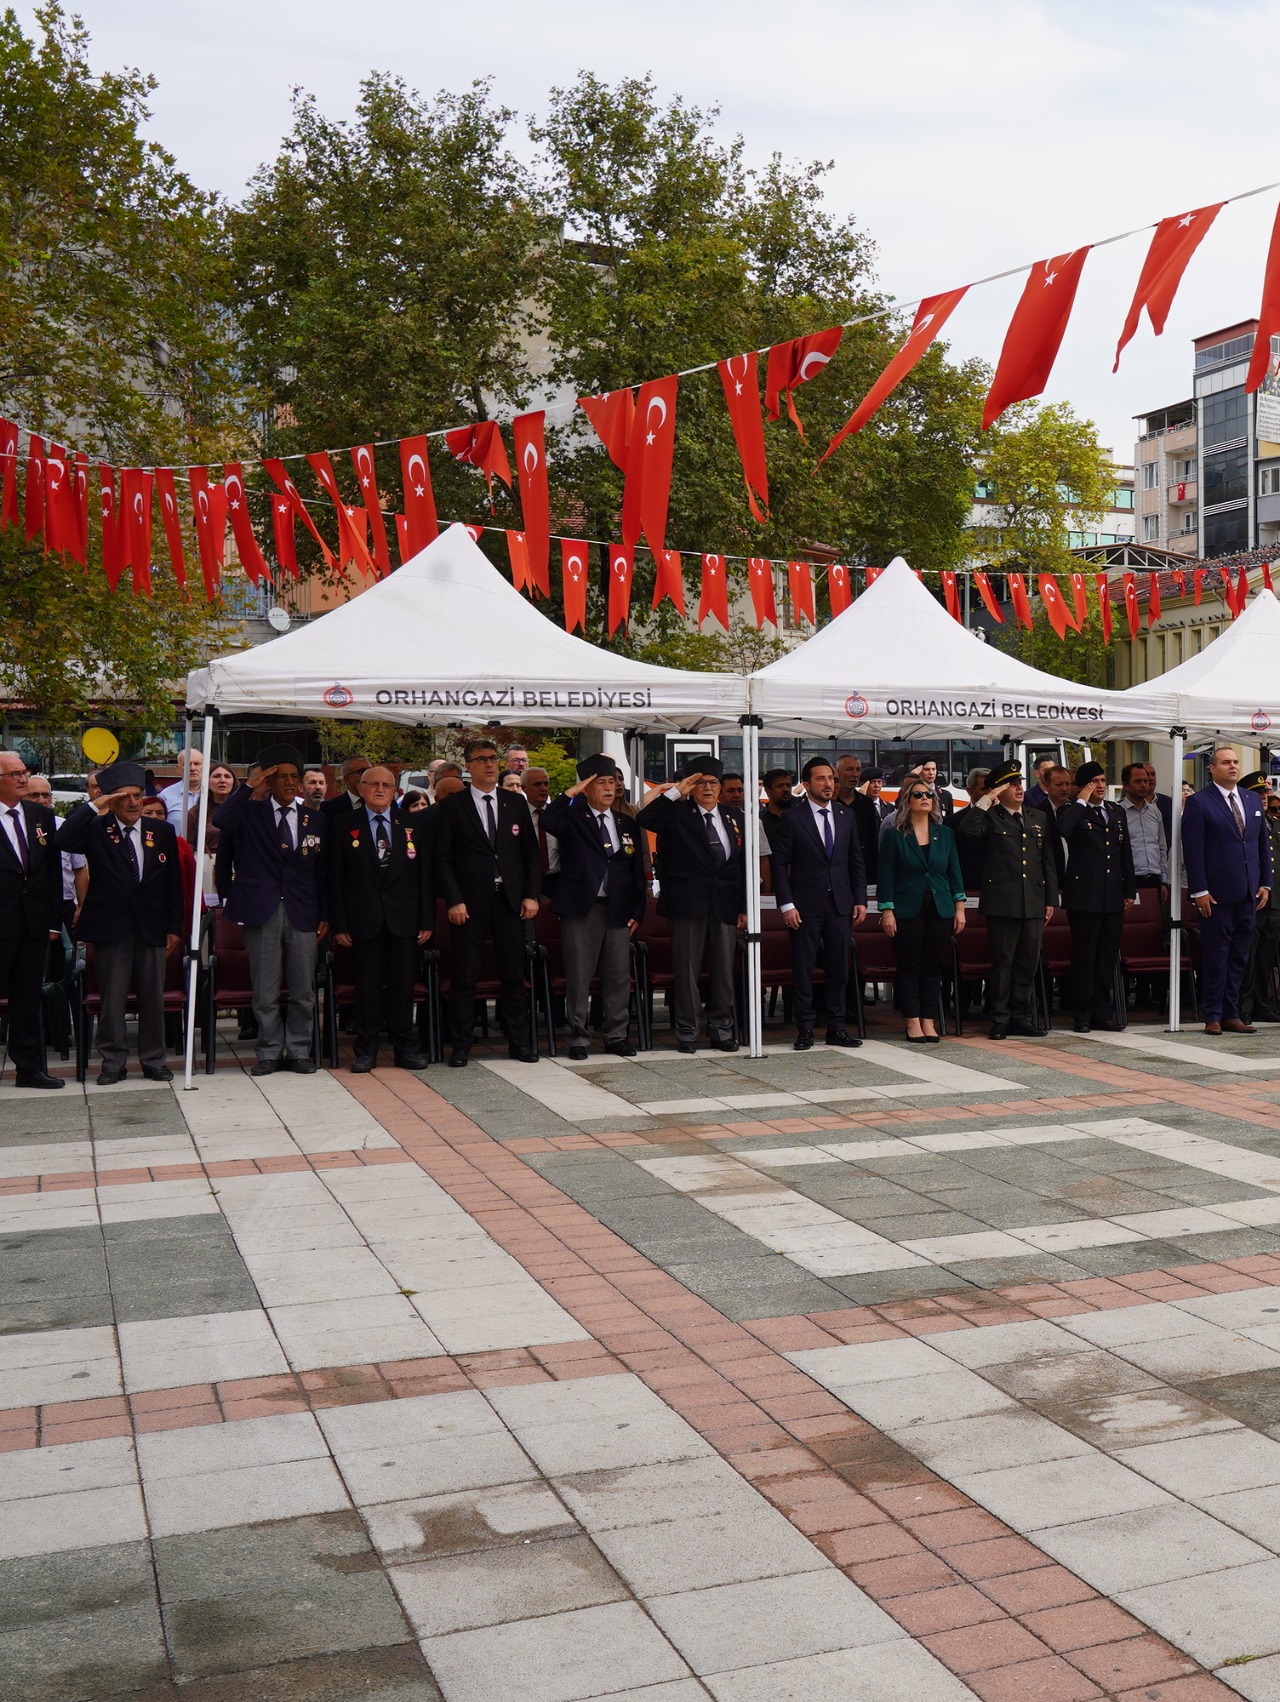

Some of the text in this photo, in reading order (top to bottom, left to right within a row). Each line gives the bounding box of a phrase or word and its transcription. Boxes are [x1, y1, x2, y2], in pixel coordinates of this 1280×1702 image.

[375, 686, 515, 708] ORHANGAZİ
[522, 687, 652, 708] BELEDİYESİ
[886, 698, 996, 718] ORHANGAZİ
[1002, 702, 1104, 721] BELEDİYESİ
